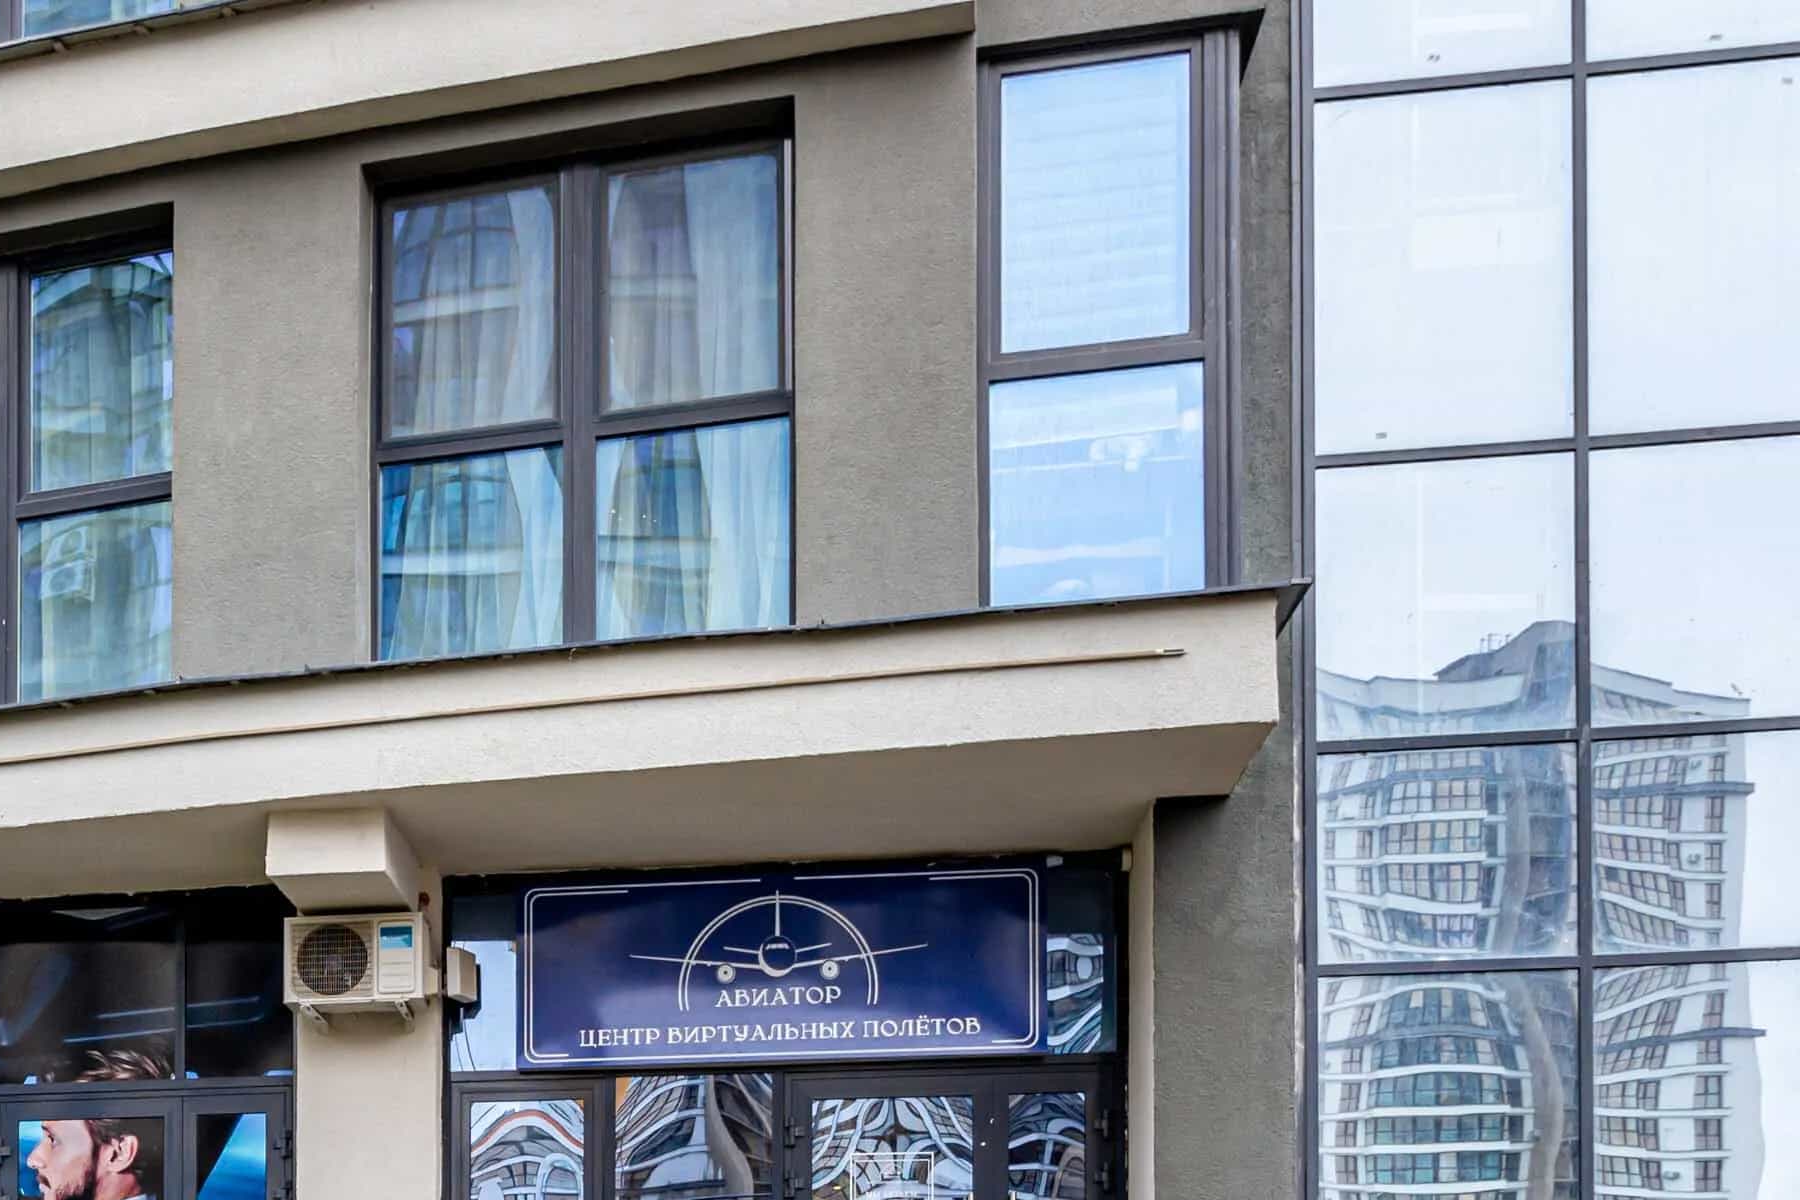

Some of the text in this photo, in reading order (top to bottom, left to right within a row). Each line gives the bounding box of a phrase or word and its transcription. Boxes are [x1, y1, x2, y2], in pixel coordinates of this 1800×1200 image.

[714, 985, 842, 1008] АВИАТОР
[579, 1014, 982, 1049] ЦЕНТР ВИРТУАЛЬНЫХ ПОЛЁТОВ
